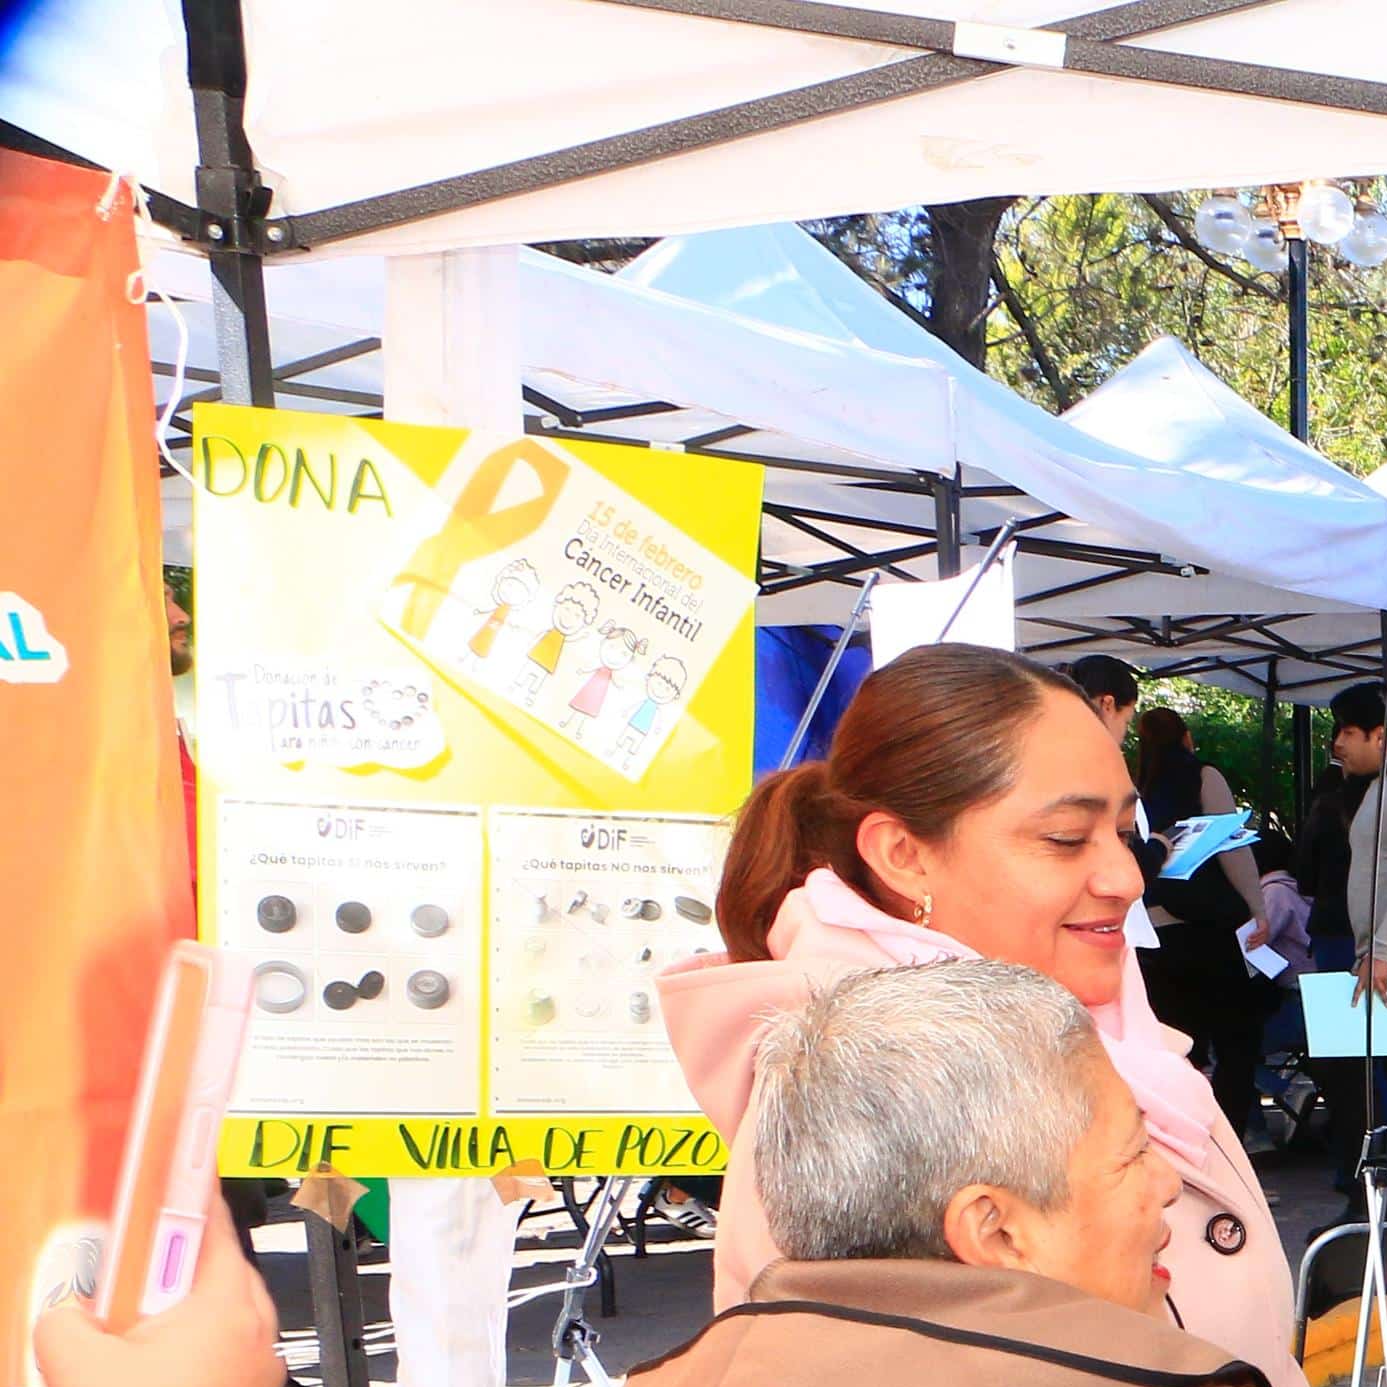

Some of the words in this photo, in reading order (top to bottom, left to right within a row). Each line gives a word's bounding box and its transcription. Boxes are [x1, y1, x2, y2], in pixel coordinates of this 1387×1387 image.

[201, 436, 395, 518] DONA
[587, 500, 616, 527] 15
[613, 520, 638, 545] de
[639, 535, 703, 590] febrero
[564, 537, 632, 594] Cáncer
[631, 583, 703, 642] Infantil
[522, 858, 556, 871] ¿Qué
[560, 859, 607, 874] tapitas
[611, 862, 630, 873] NO
[633, 864, 656, 874] nos
[249, 1120, 353, 1173] DIF
[543, 1127, 603, 1170] DE
